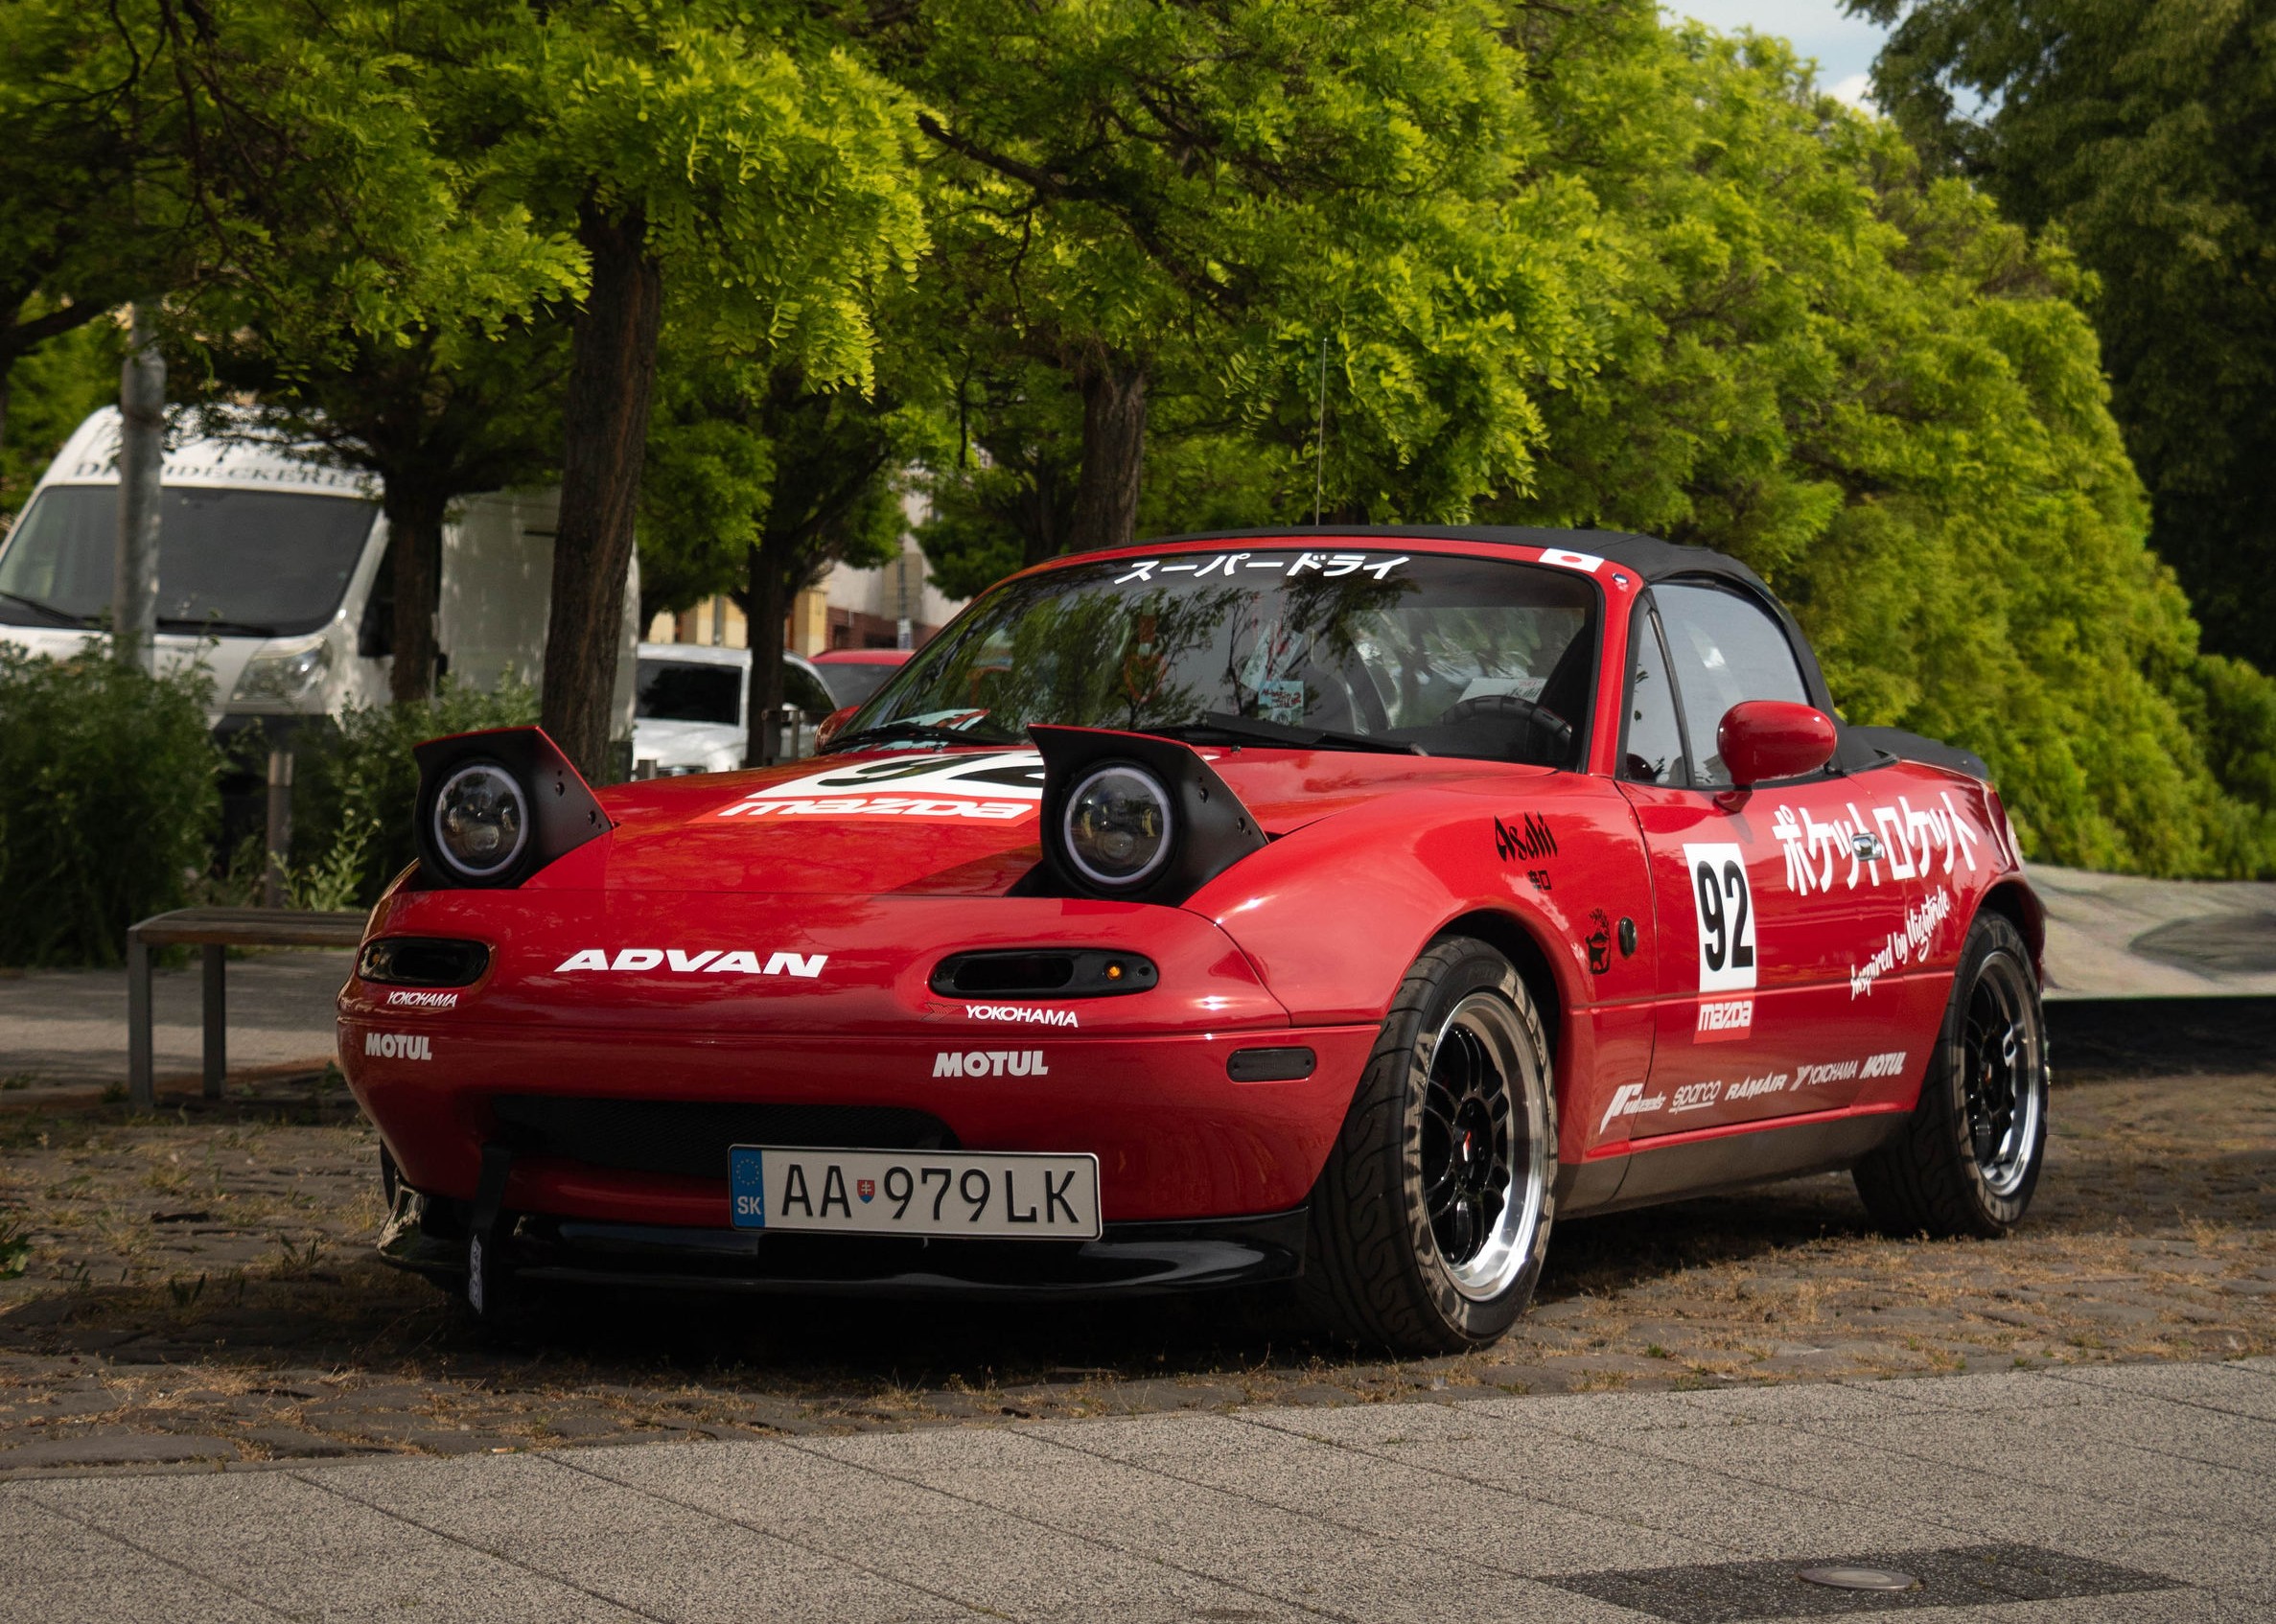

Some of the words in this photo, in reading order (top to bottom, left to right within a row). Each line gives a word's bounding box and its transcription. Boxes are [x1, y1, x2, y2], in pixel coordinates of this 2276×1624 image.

[1114, 552, 1409, 585] スーパードライ
[718, 798, 1033, 820] mazda
[1495, 811, 1558, 862] Asahi
[1772, 792, 1978, 896] ポケットロケット
[1697, 860, 1753, 972] 92
[553, 948, 828, 978] ADVAN
[1850, 934, 1894, 1001] Inspired
[1893, 931, 1908, 964] by
[386, 991, 458, 1009] YOKOHAMA
[1697, 1000, 1753, 1031] mazda
[965, 1005, 1079, 1028] YOKOHAMA
[365, 1032, 432, 1060] MOTUL
[932, 1050, 1049, 1078] MOTUL
[1671, 1080, 1722, 1113] sparco
[1725, 1073, 1788, 1101] RAMAIR
[1808, 1061, 1859, 1085] YOKOHAMA
[1859, 1052, 1907, 1079] MOTUL
[737, 1195, 761, 1215] SK
[781, 1164, 852, 1218] AA
[883, 1166, 1080, 1223] 979LK
